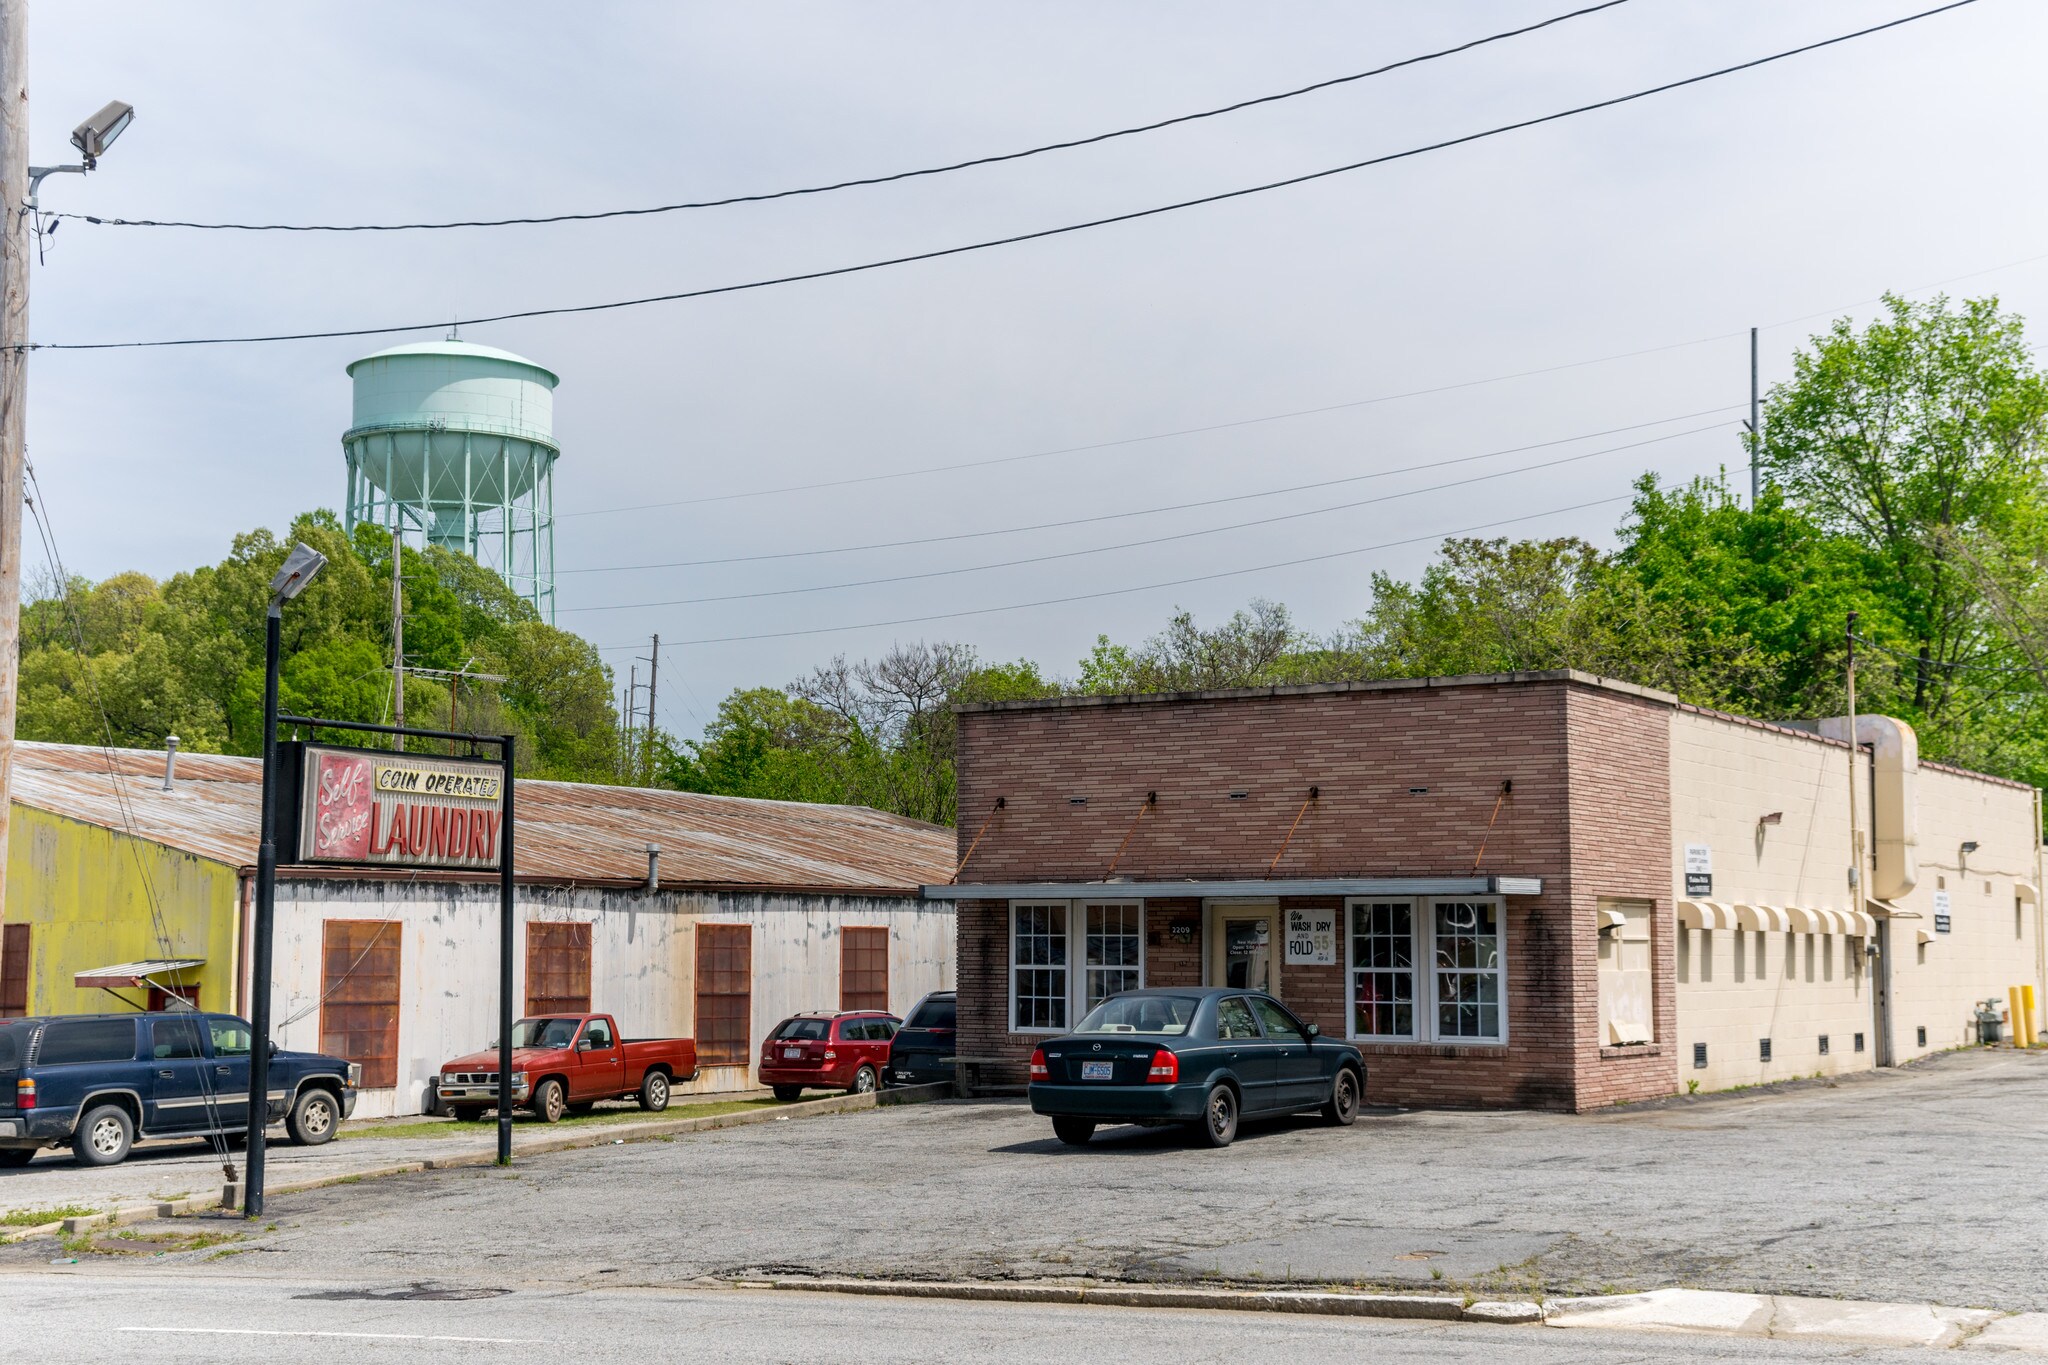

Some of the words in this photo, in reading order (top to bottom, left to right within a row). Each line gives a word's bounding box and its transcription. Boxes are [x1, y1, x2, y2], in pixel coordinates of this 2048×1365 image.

[320, 763, 365, 806] Self
[380, 769, 419, 790] COIN
[425, 773, 499, 797] OPERATED
[319, 809, 368, 850] Service
[370, 802, 503, 859] LAUNDRY
[1290, 911, 1303, 921] We
[1290, 921, 1311, 932] WASH
[1316, 921, 1331, 932] DRY
[1172, 926, 1190, 934] 2209
[1289, 940, 1313, 955] FOLD
